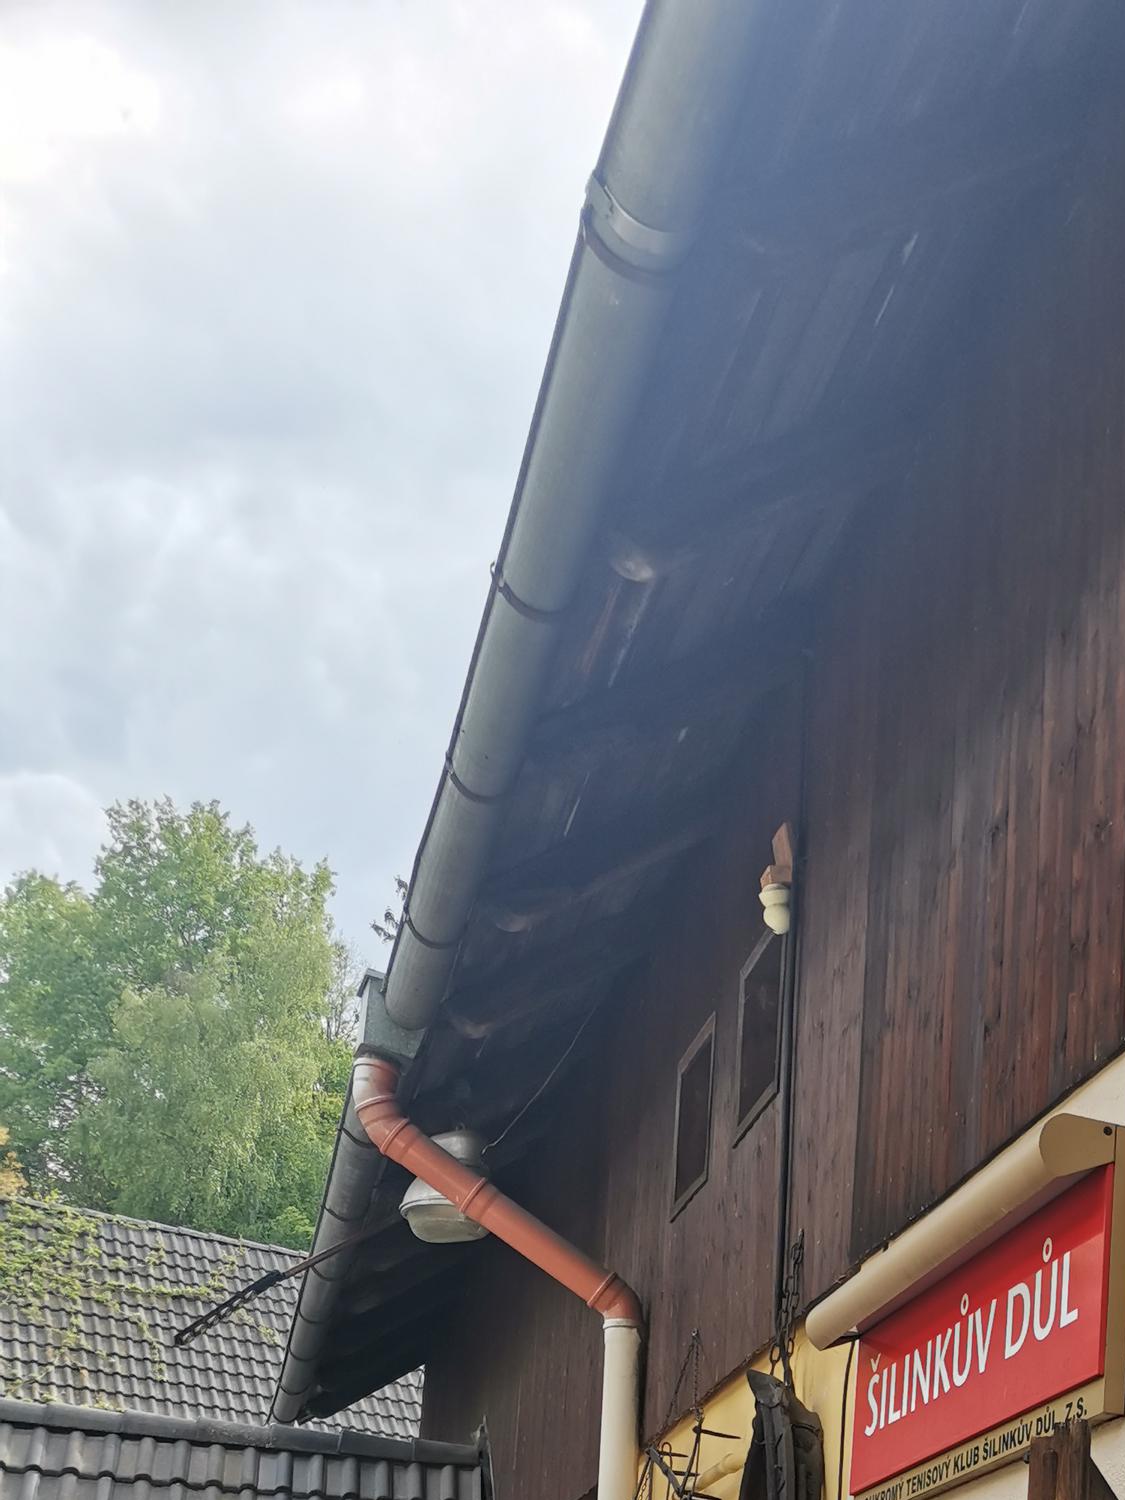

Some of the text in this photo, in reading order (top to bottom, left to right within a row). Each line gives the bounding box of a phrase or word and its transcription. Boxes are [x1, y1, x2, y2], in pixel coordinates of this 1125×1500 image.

[864, 1237, 1078, 1437] ŠILINKŮV DŮL
[906, 1456, 951, 1495] TENISOVÝ
[953, 1445, 980, 1475] KLUB
[982, 1417, 1033, 1462] ŠILINKŮV
